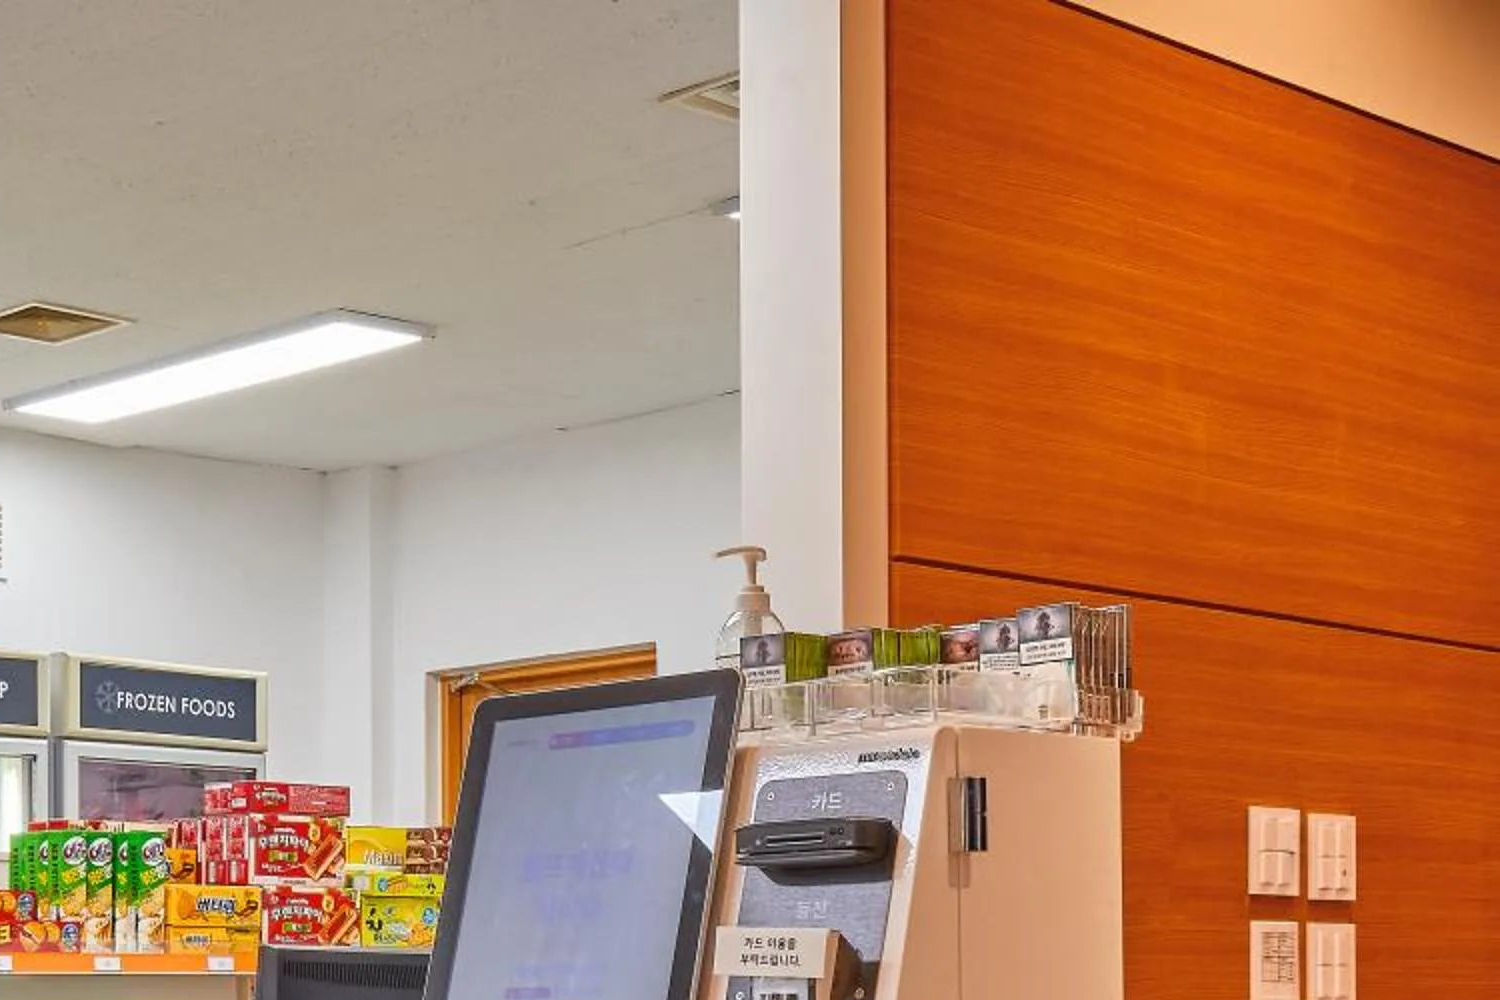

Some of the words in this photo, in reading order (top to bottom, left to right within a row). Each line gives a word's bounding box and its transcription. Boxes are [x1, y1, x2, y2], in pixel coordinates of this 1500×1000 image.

[116, 690, 177, 714] FROZEN
[182, 697, 236, 720] FOODS
[811, 791, 843, 811] 카드
[744, 937, 765, 950] 카드
[767, 937, 797, 951] 이용을
